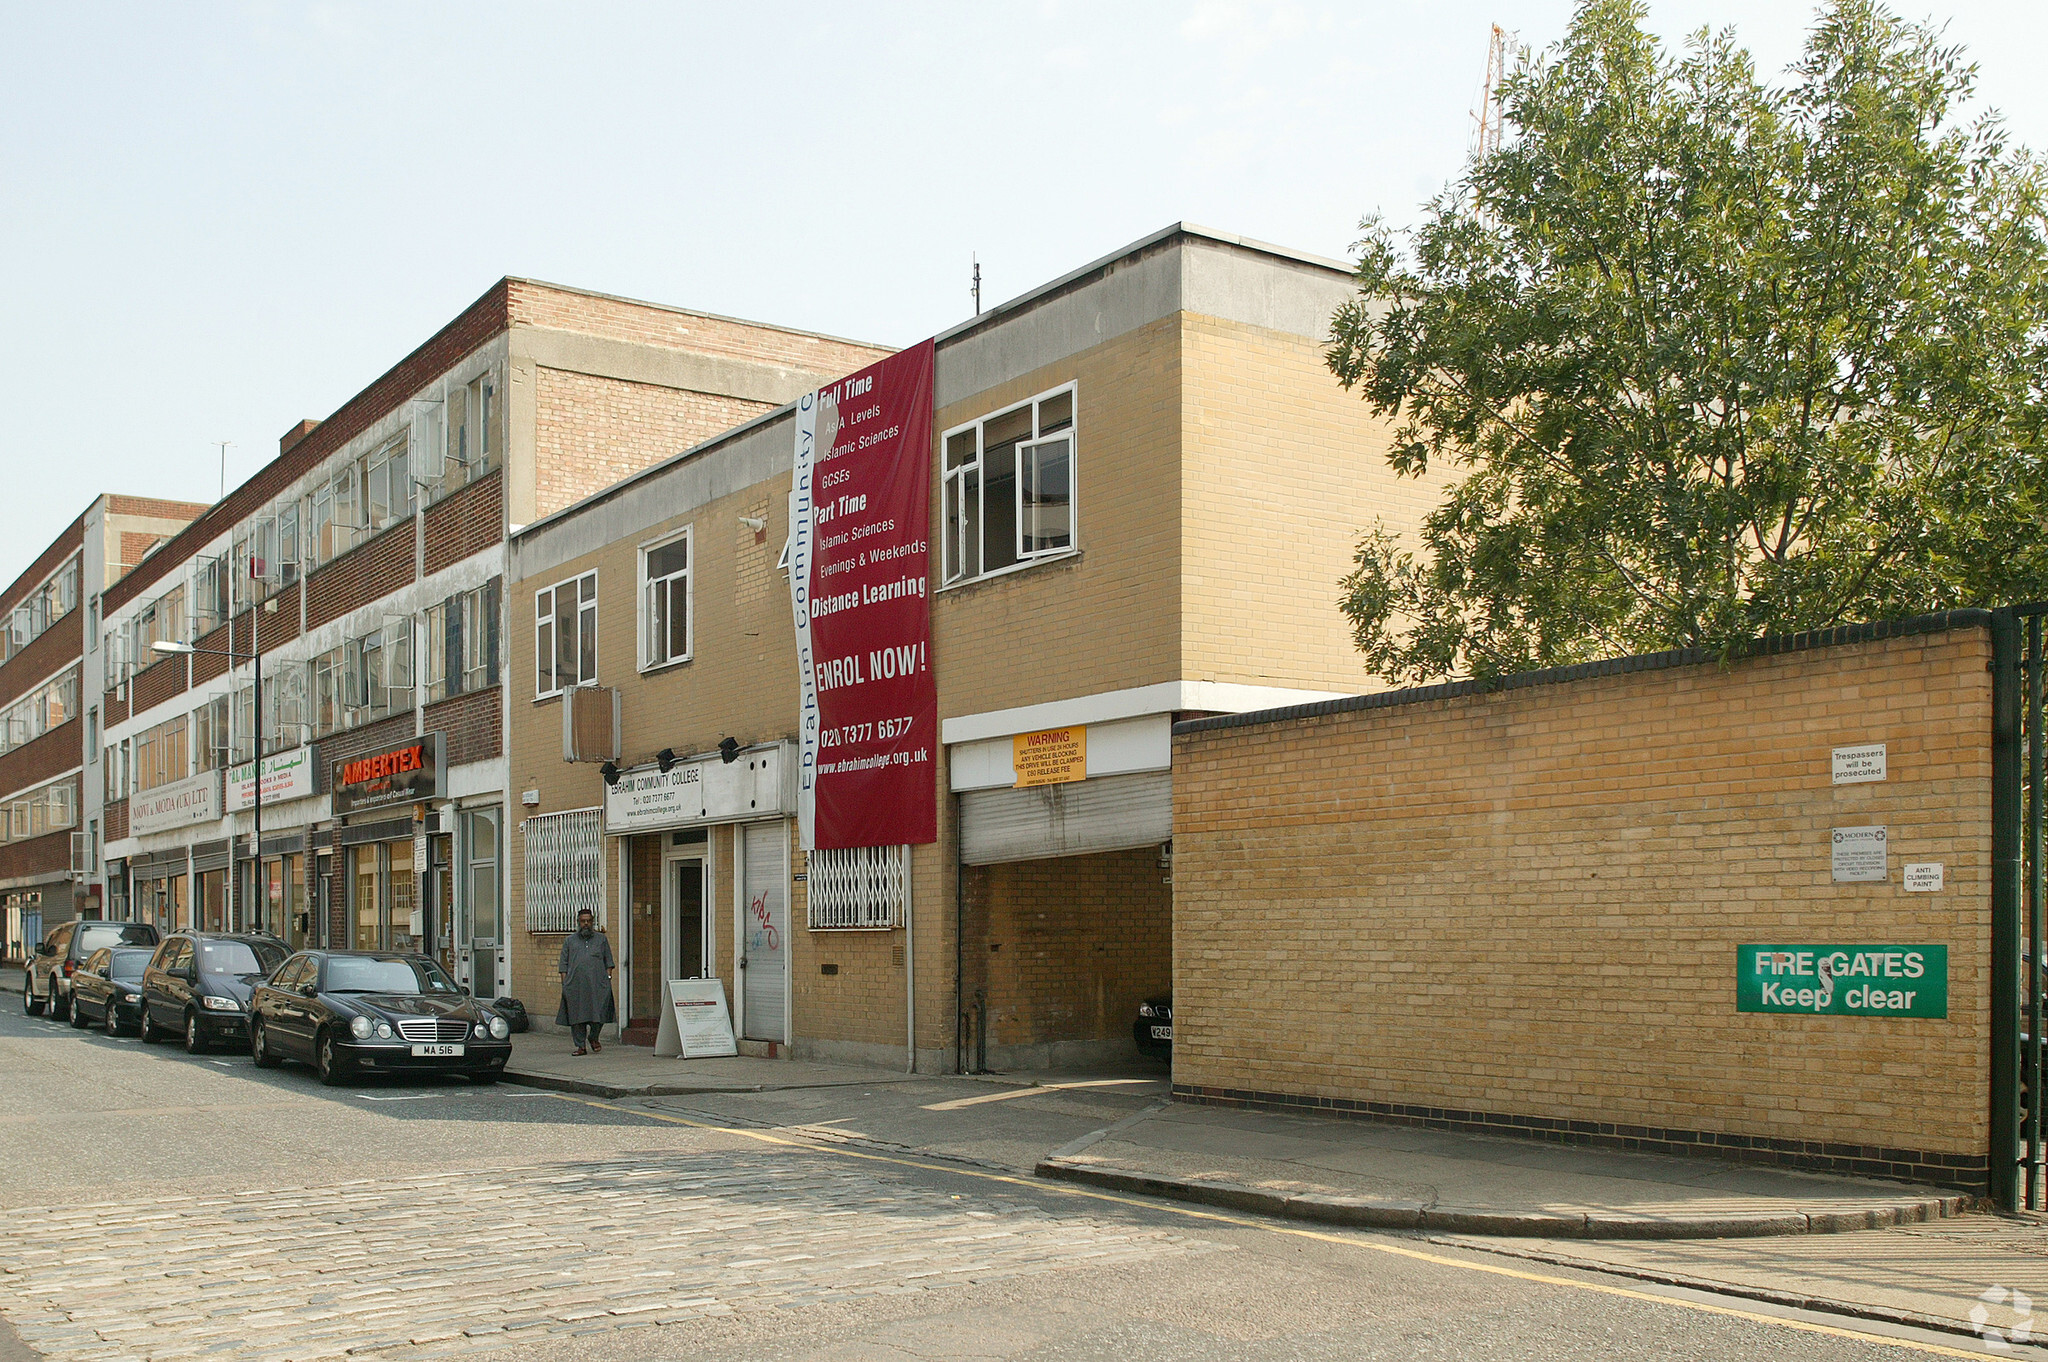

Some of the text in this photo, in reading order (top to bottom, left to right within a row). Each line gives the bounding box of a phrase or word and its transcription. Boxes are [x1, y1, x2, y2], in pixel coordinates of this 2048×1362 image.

[820, 376, 872, 411] Full Time
[851, 405, 880, 425] Levels
[824, 424, 899, 462] Islamic Sciences
[822, 469, 850, 489] GCSEs
[814, 494, 867, 526] Part Time
[820, 519, 894, 551] Islamic Sciences
[820, 540, 926, 579] Evenings & Weekends
[811, 575, 926, 618] Distance Learning
[795, 430, 815, 790] Ebrahim Community
[816, 641, 926, 692] ENROL NOW!
[821, 716, 913, 748] 020 7377 6677
[1028, 731, 1069, 746] WARNING
[818, 747, 928, 775] www.ebrahimcollege.org.uk
[1020, 747, 1041, 755] SHUTTERS
[1052, 750, 1077, 758] BLOCKING
[1060, 756, 1083, 765] CLAMPED
[1835, 750, 1884, 760] Trespassers
[232, 761, 266, 784] AL MANR
[342, 745, 424, 786] AMBERTEX
[1037, 767, 1060, 776] RELEASE
[1835, 768, 1882, 778] prosecuted
[612, 769, 698, 795] EBRAHIM COMMUNITY COLLEGE
[1755, 952, 1925, 978] FIRE GATES
[1762, 982, 1917, 1012] Keep clear
[424, 1046, 452, 1054] MA 516
